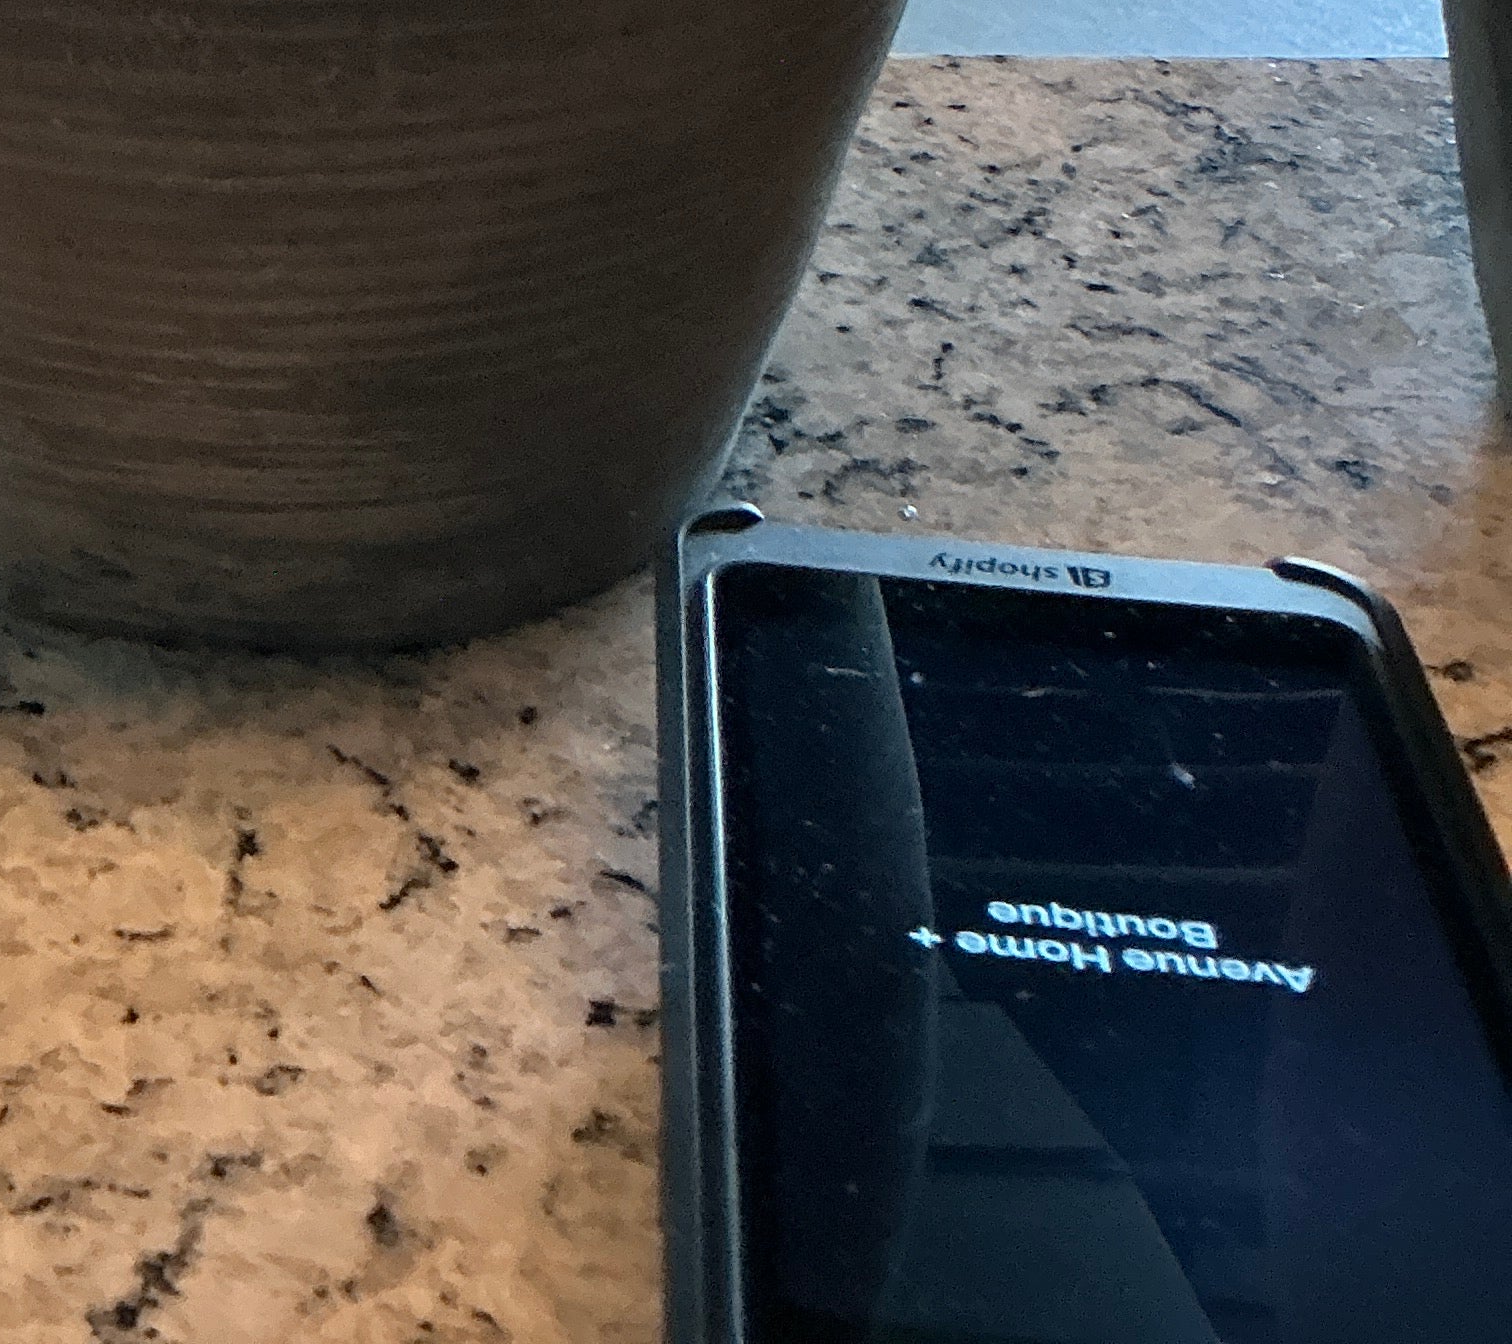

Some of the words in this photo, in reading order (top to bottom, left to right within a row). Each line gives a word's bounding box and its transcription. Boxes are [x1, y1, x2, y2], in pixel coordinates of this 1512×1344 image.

[929, 552, 1059, 582] shopify
[987, 900, 1219, 950] Boutique
[955, 930, 1112, 973] Home
[1122, 947, 1315, 993] Avenue
